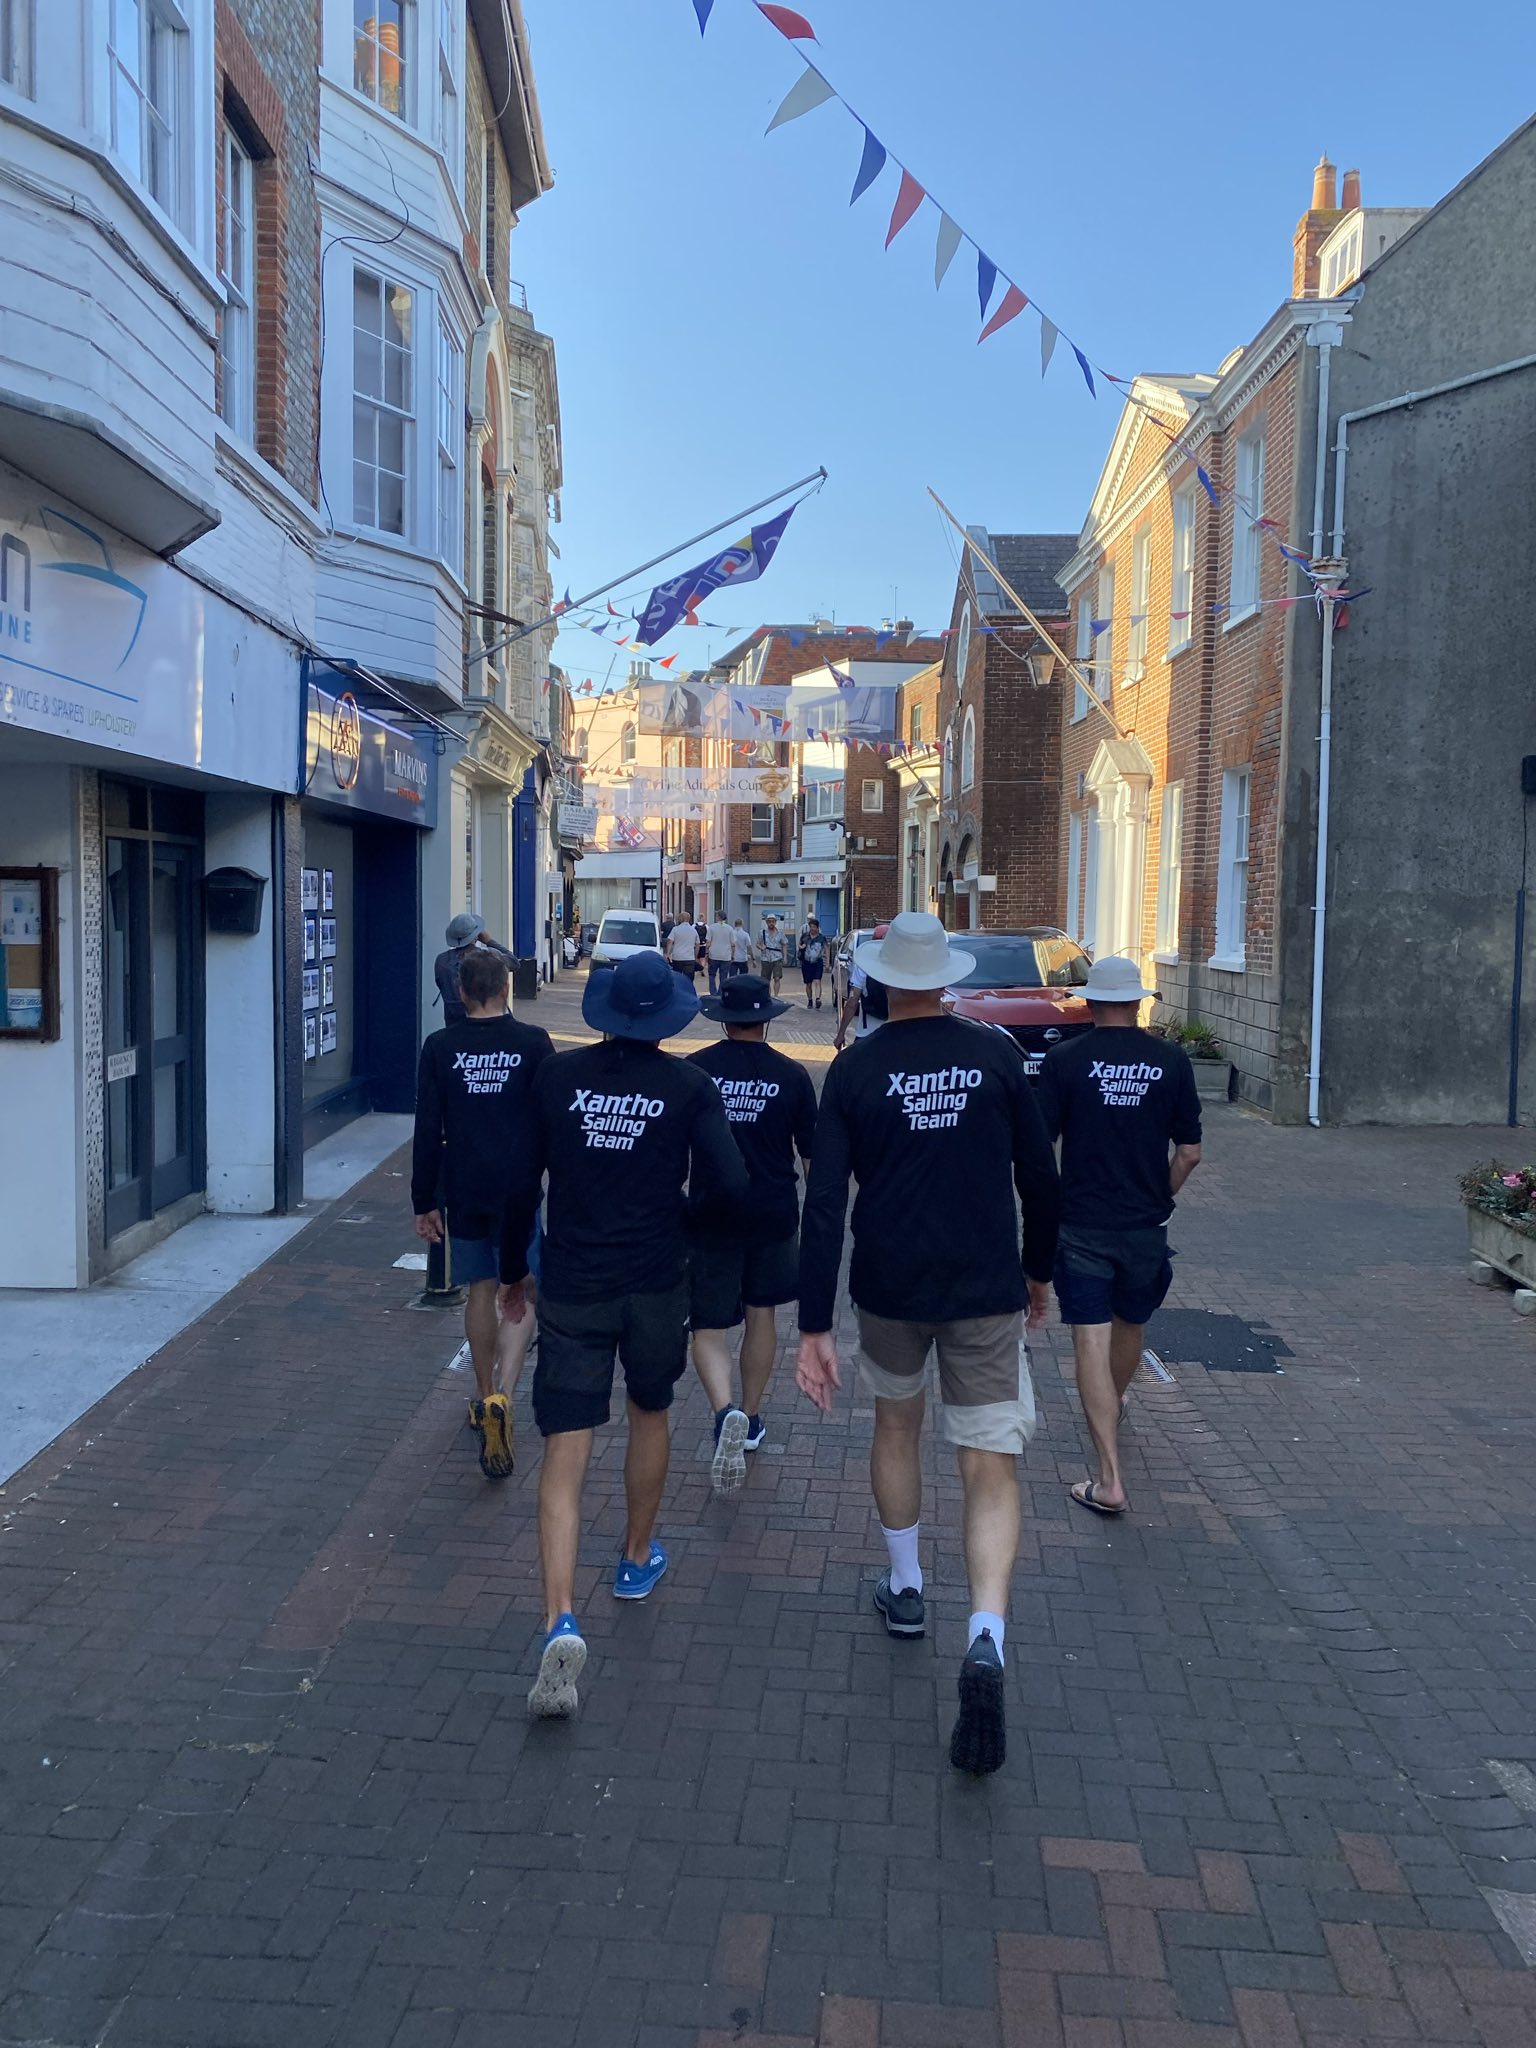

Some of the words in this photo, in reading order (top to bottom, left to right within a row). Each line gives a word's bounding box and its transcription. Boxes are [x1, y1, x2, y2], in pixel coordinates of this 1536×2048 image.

[42, 695, 49, 714] &
[51, 697, 84, 724] SPARES
[88, 708, 137, 737] UPHOLSTERY
[394, 749, 428, 786] MARVINS
[738, 778, 763, 793] Cup
[452, 1050, 522, 1069] Xantho
[463, 1068, 510, 1082] Sailing
[1088, 1060, 1163, 1081] Xantho
[467, 1081, 503, 1094] Team
[885, 1066, 983, 1097] Xantho
[1099, 1079, 1150, 1096] Sailing
[568, 1088, 665, 1118] Xantho
[902, 1092, 968, 1114] Sailing
[1103, 1092, 1141, 1106] Team
[580, 1113, 647, 1137] Sailing
[908, 1111, 959, 1131] Team
[586, 1131, 635, 1151] Team
